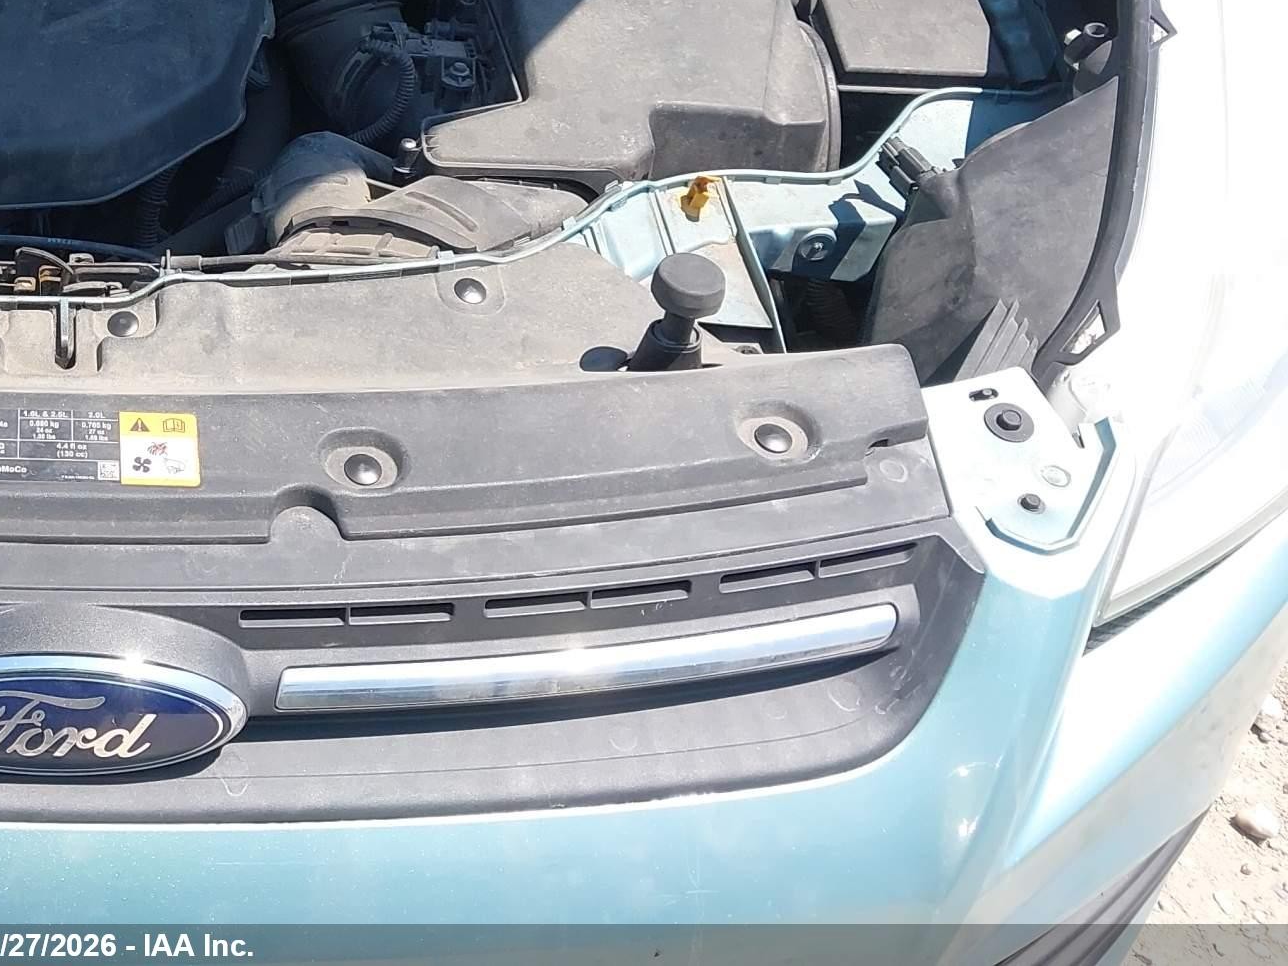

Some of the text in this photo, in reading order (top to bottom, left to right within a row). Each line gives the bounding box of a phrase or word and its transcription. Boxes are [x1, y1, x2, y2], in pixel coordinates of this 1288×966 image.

[49, 420, 60, 429] kg
[102, 422, 112, 431] kg
[56, 451, 73, 459] (130
